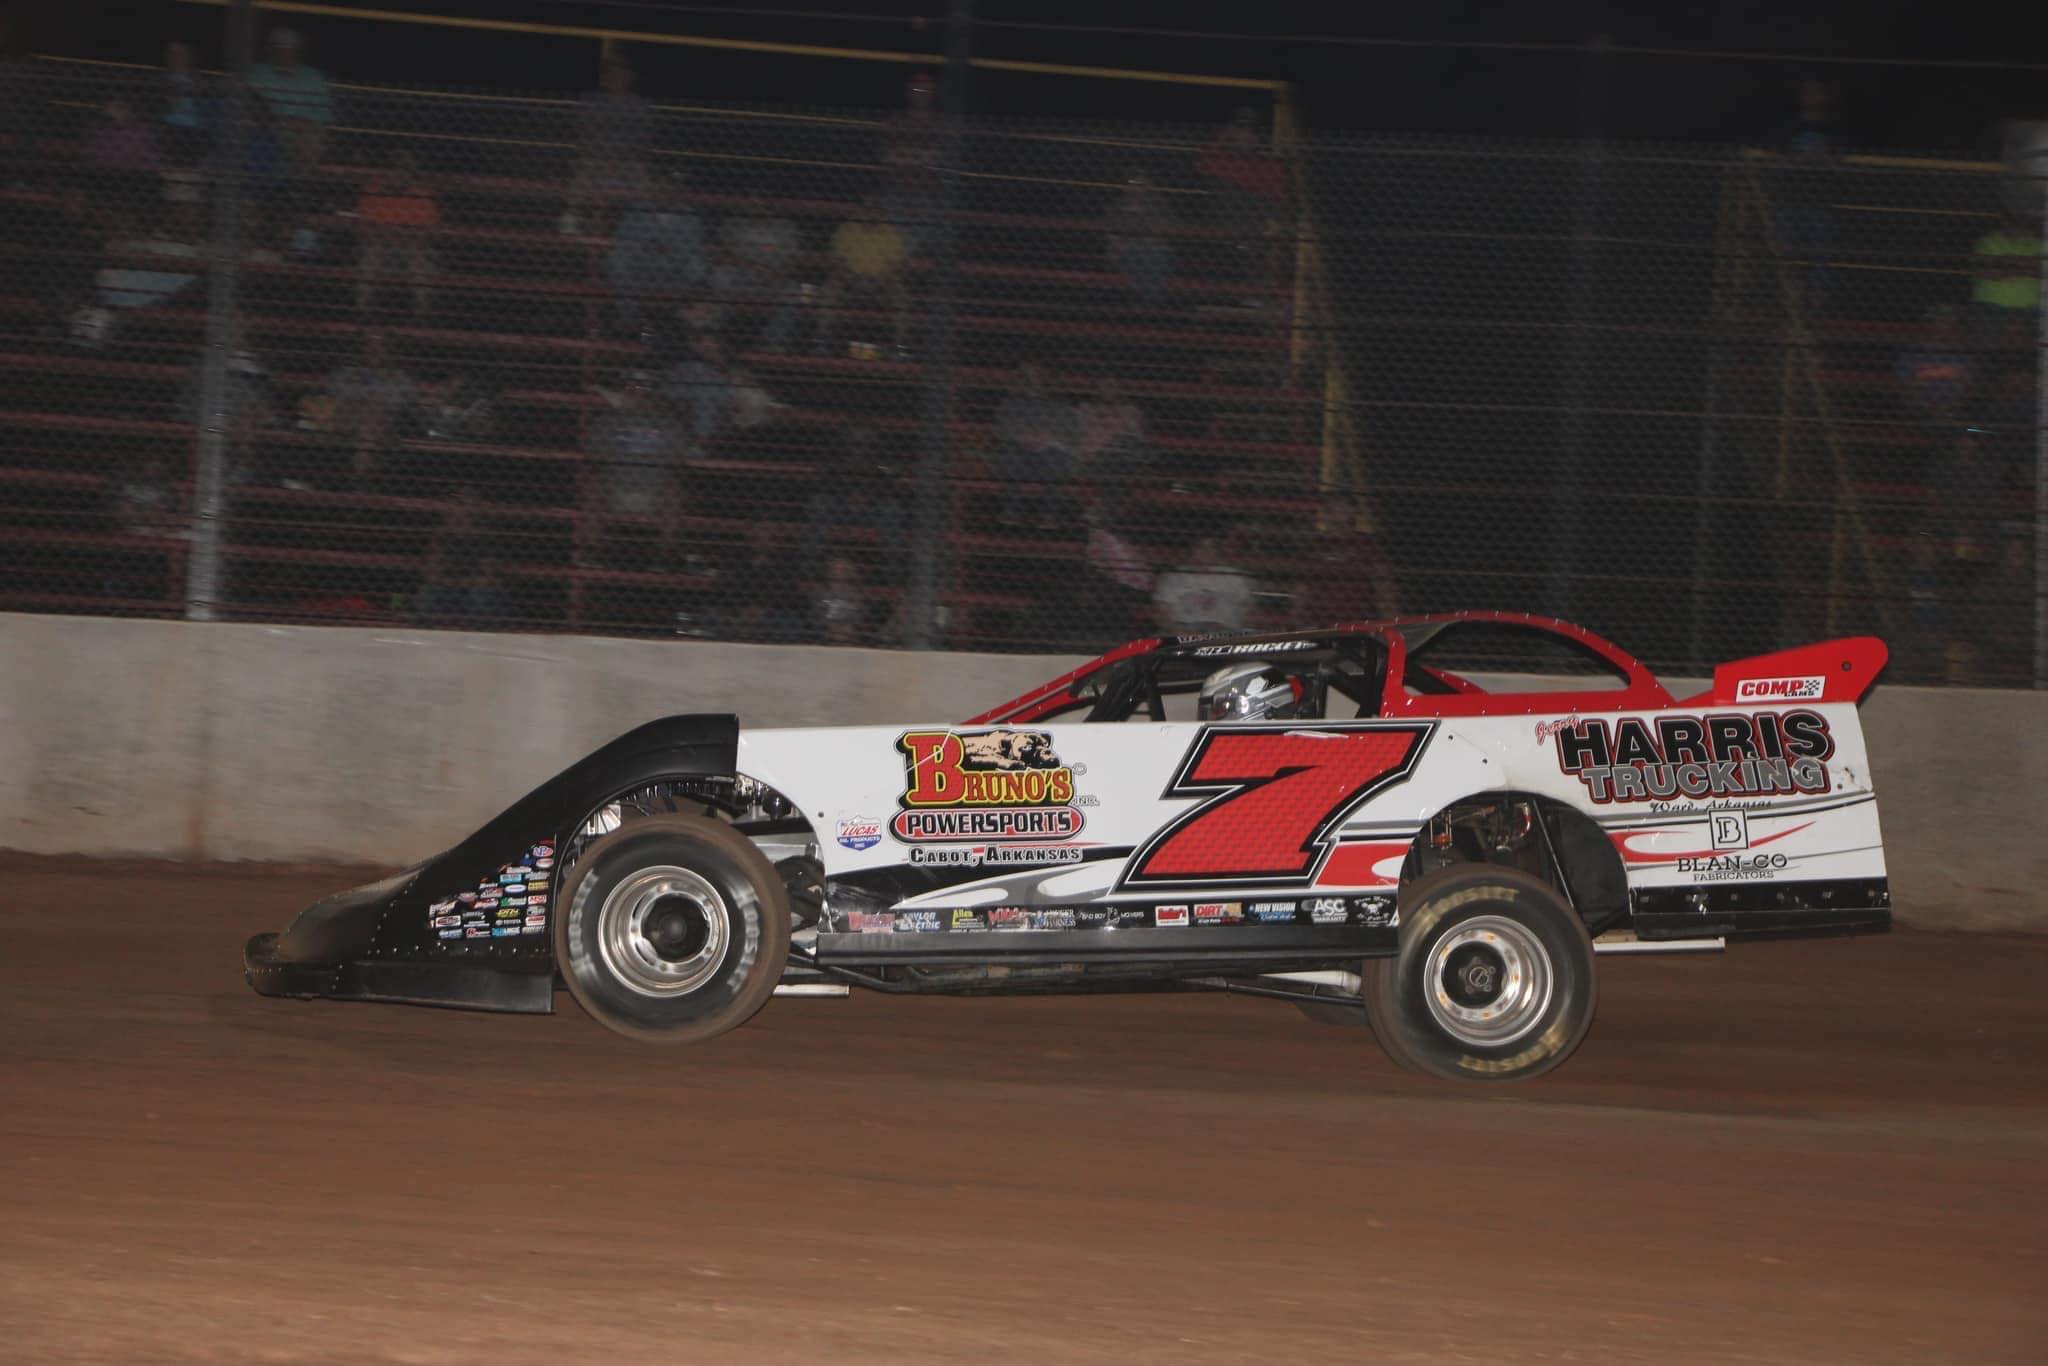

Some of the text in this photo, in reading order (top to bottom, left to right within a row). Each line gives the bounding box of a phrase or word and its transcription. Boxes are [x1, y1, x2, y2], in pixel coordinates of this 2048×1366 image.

[1741, 680, 1804, 697] COMP
[1558, 710, 1833, 771] HARRIS
[904, 731, 1074, 805] BRUNO'S
[1581, 758, 1828, 801] TRUCKING
[1118, 723, 1436, 888] 7
[841, 825, 877, 836] LUCAS
[907, 811, 1073, 835] POWERSPORTS
[910, 846, 1081, 865] CABOT, ARKANSAS
[1677, 854, 1787, 873] BLAN-CO
[1693, 870, 1775, 881] FABRICATORS
[1196, 906, 1222, 916] DIRT
[1254, 902, 1297, 913] NEW VISION
[1314, 900, 1345, 915] ASC
